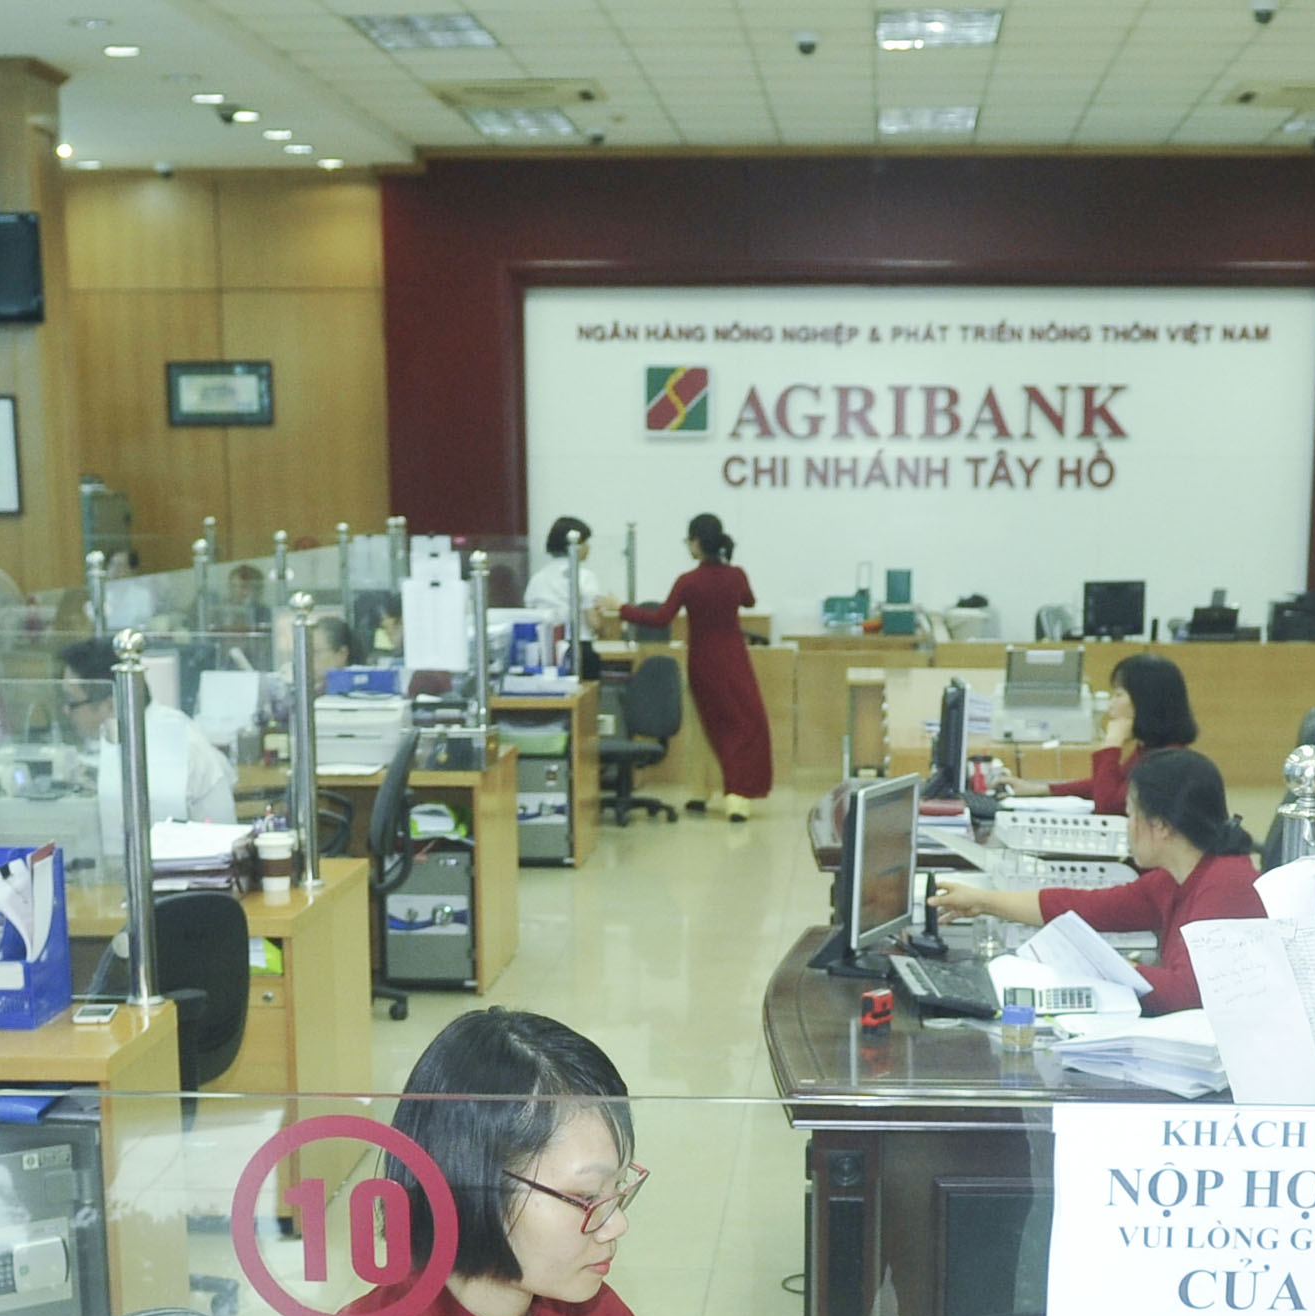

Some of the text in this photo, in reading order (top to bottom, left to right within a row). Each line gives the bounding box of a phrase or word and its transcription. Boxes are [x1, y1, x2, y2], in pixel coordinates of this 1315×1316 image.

[577, 321, 1270, 346] NGÂN HÀNG NÔNG NGHIỆP & PHÁT TRIỂN NÔNG THÔN VIỆT NAM
[729, 383, 1128, 440] AGRIBANK
[722, 441, 1116, 488] CHI NHÁNH TÂY HỒ
[1162, 1114, 1307, 1148] KHÁCH
[1107, 1161, 1224, 1218] NỘP
[284, 1177, 412, 1285] 10
[1119, 1226, 1174, 1249] VUI
[1185, 1220, 1280, 1250] LÒNG
[1178, 1258, 1307, 1312] CỬA
